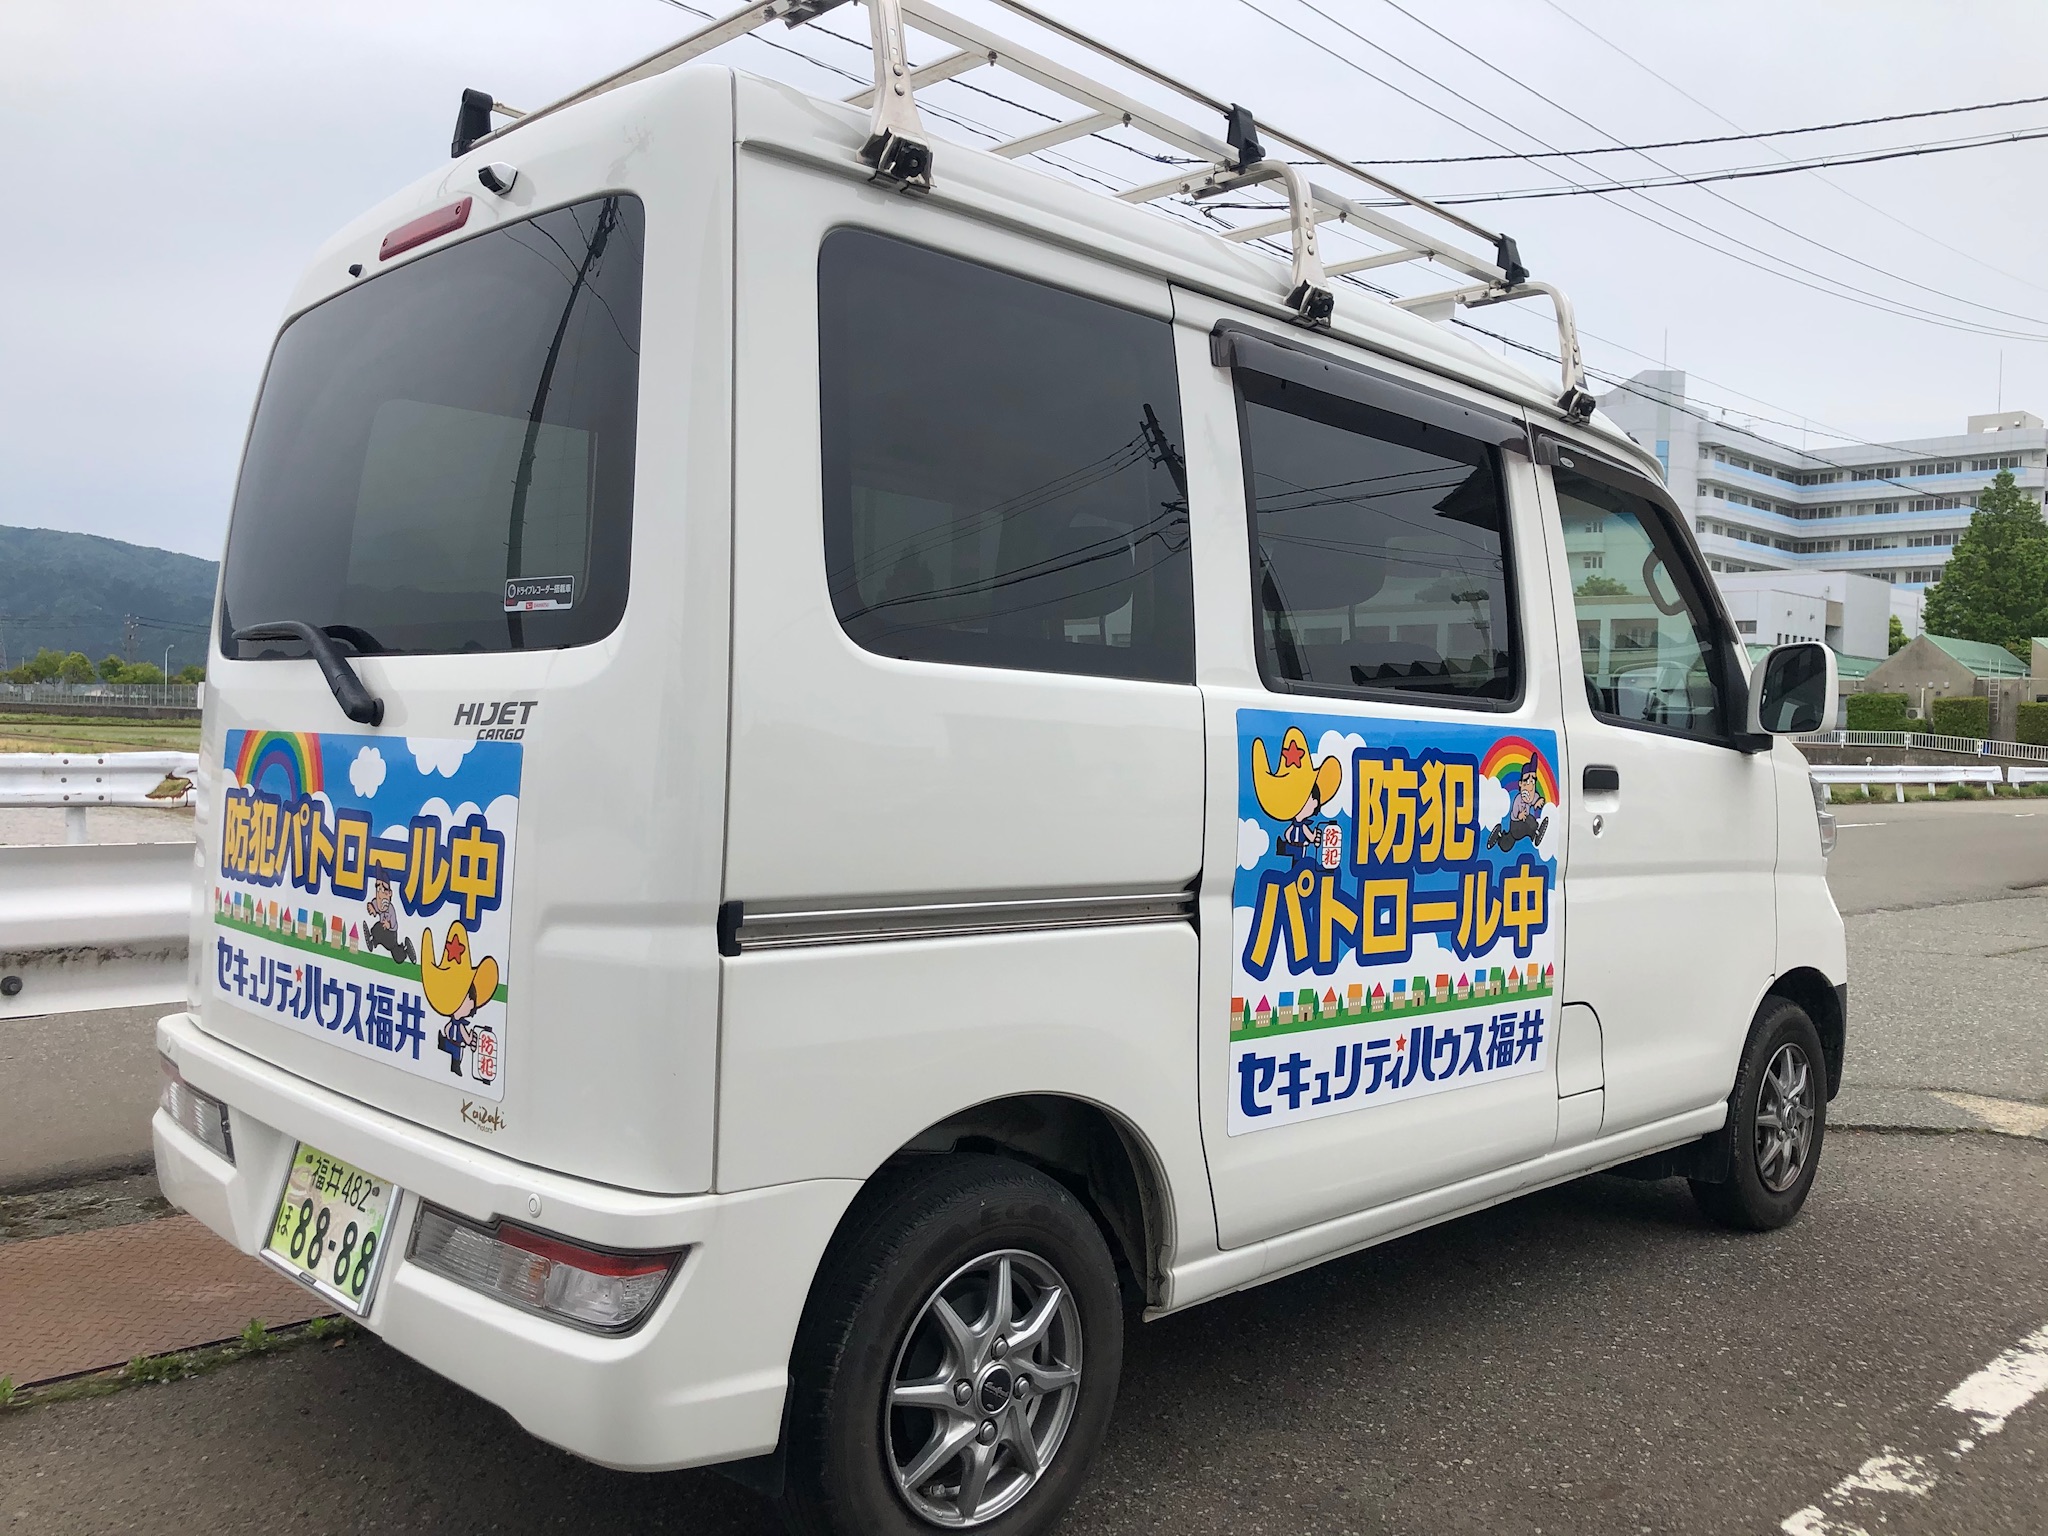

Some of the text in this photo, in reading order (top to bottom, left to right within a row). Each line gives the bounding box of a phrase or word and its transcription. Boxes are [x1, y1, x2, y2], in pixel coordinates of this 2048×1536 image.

[454, 701, 538, 725] HIJET
[476, 729, 525, 740] CARGO
[222, 793, 501, 925] 防犯パトロール中
[1322, 827, 1339, 867] 防犯
[1356, 758, 1476, 866] 防犯
[1249, 863, 1545, 967] パトロール中
[217, 936, 427, 1060] セキュリティハウス福井
[478, 1031, 496, 1077] 防犯
[1237, 1008, 1544, 1118] セキュリティハウス福井
